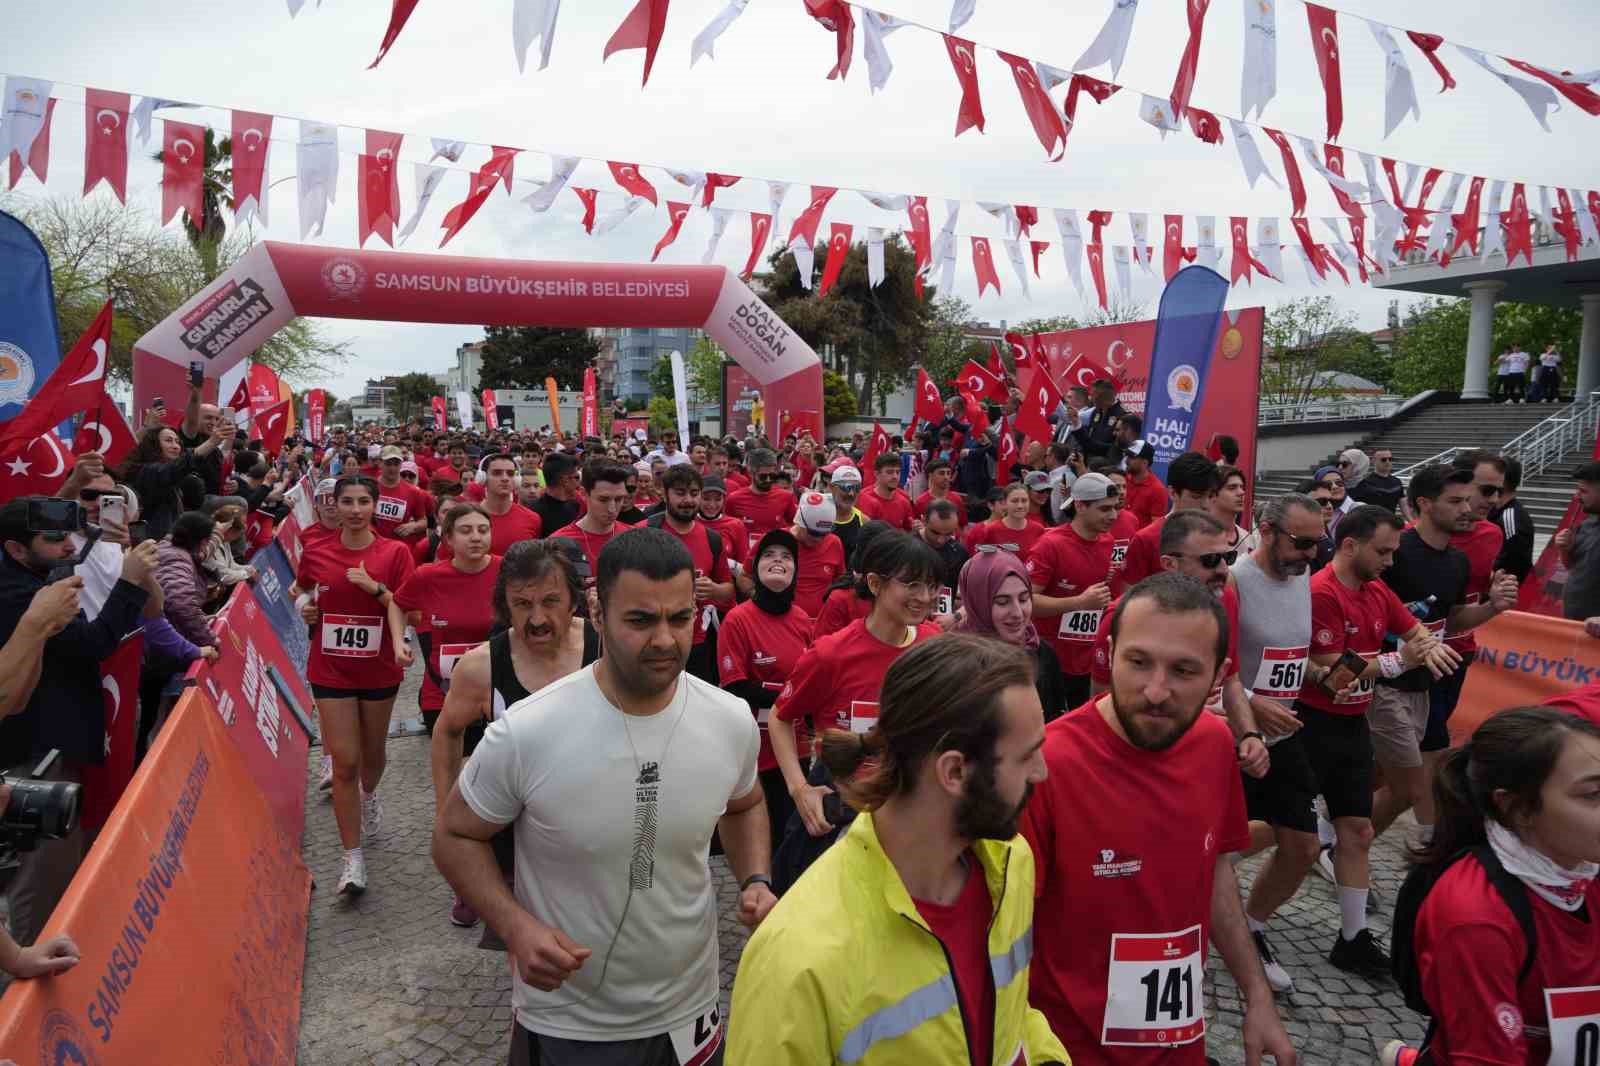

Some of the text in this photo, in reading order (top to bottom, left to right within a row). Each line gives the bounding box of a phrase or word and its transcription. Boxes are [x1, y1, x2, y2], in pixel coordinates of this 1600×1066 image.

[375, 272, 690, 299] SAMSUN BÜYÜKŞEHİR BELEDİYESİ
[187, 286, 257, 344] GURURLA
[206, 300, 269, 354] SAMSUN
[380, 502, 399, 516] 150
[1069, 612, 1098, 632] 486
[334, 627, 369, 648] 149
[1269, 662, 1303, 688] 561
[87, 916, 147, 1043] SAMSUN
[1140, 964, 1195, 1022] 141
